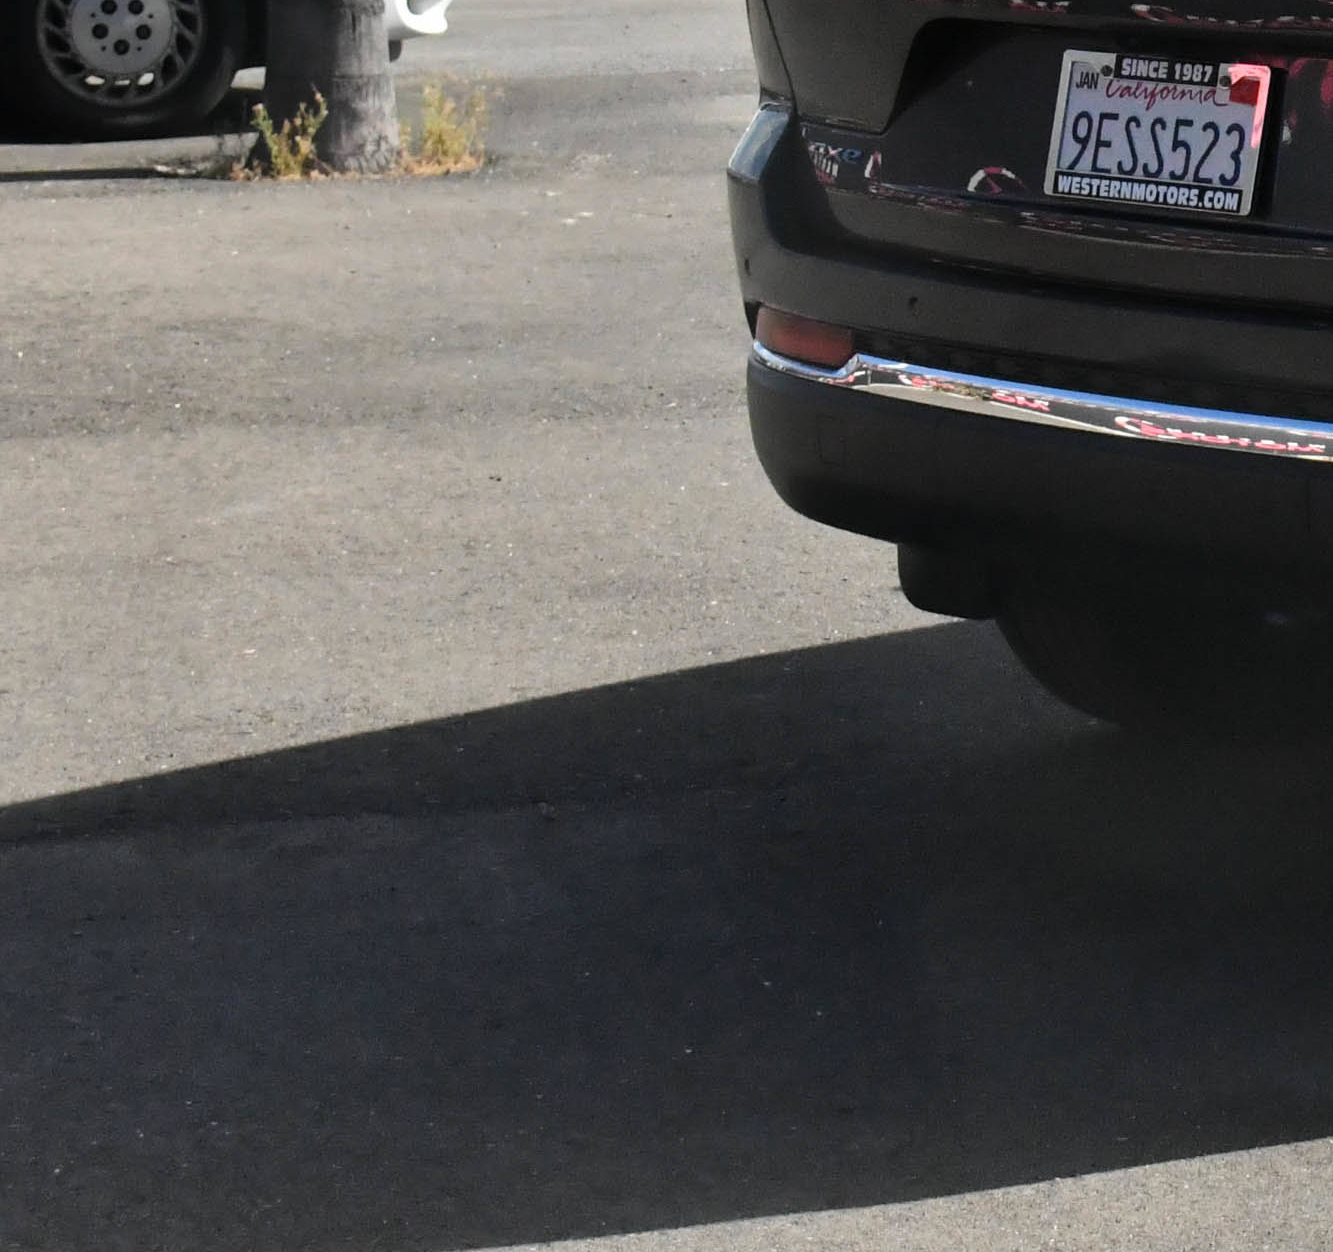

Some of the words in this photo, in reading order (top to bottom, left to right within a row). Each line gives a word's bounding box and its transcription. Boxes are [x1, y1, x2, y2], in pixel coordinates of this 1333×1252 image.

[1075, 70, 1099, 90] JAN
[1121, 57, 1168, 80] SINCE
[1174, 61, 1213, 83] 1987
[1105, 78, 1228, 111] California
[1067, 110, 1246, 187] 9ESS523
[1057, 175, 1239, 212] WESTERNMOTORS.COM
